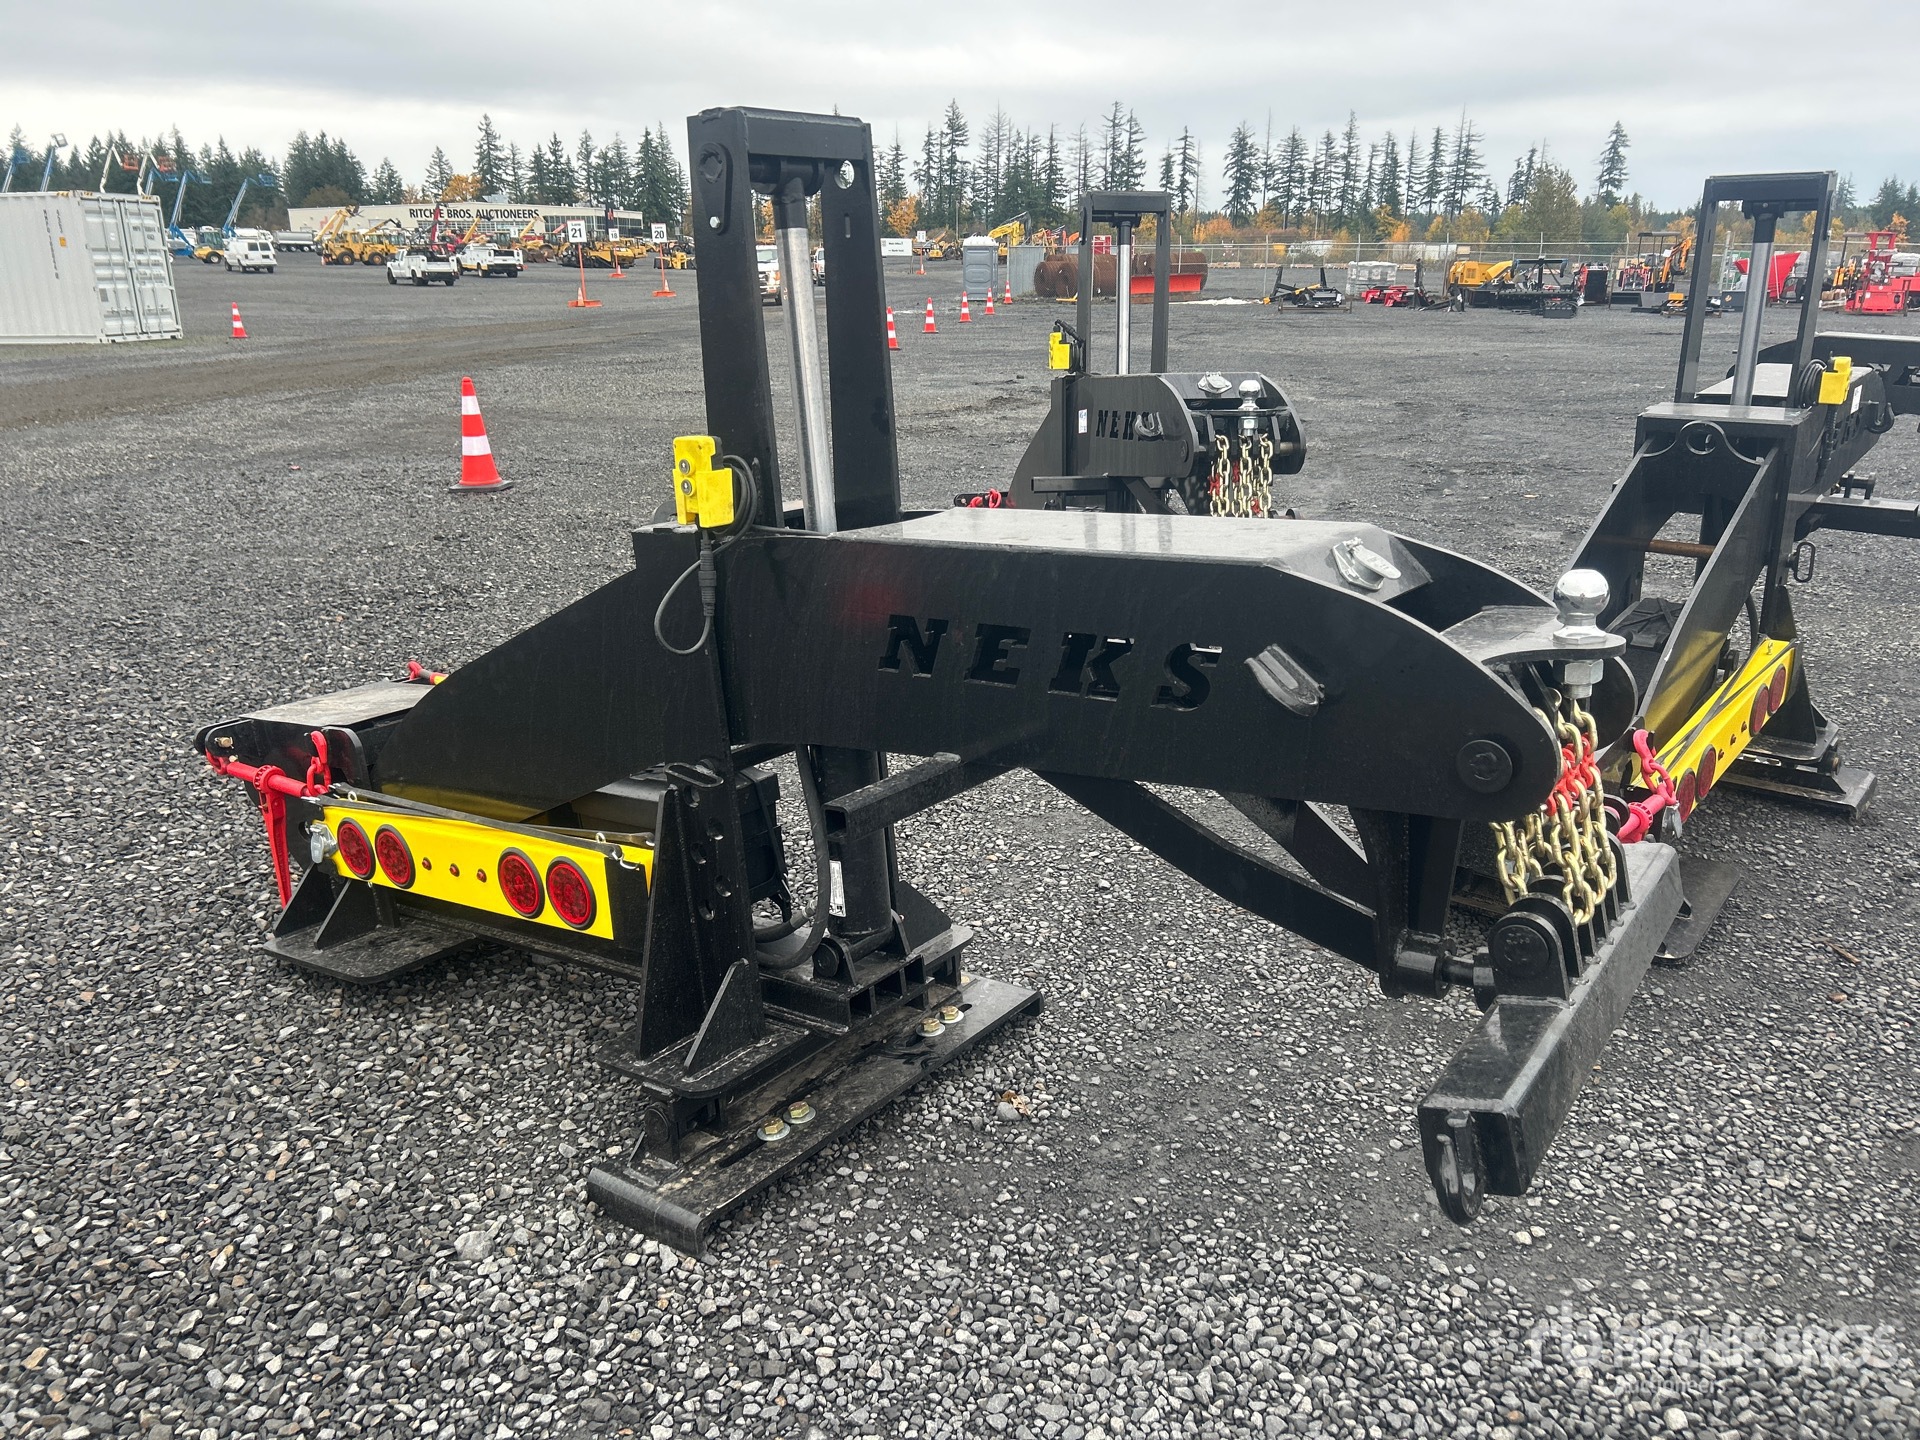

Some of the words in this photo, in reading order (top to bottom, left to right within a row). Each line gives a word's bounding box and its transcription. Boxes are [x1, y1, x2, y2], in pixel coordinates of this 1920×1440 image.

[409, 208, 445, 218] RITCHE
[447, 209, 474, 219] BROS.
[476, 208, 539, 219] AUCTIONEERS
[570, 227, 583, 239] 21
[654, 230, 665, 240] 20
[876, 614, 1223, 713] NEKS
